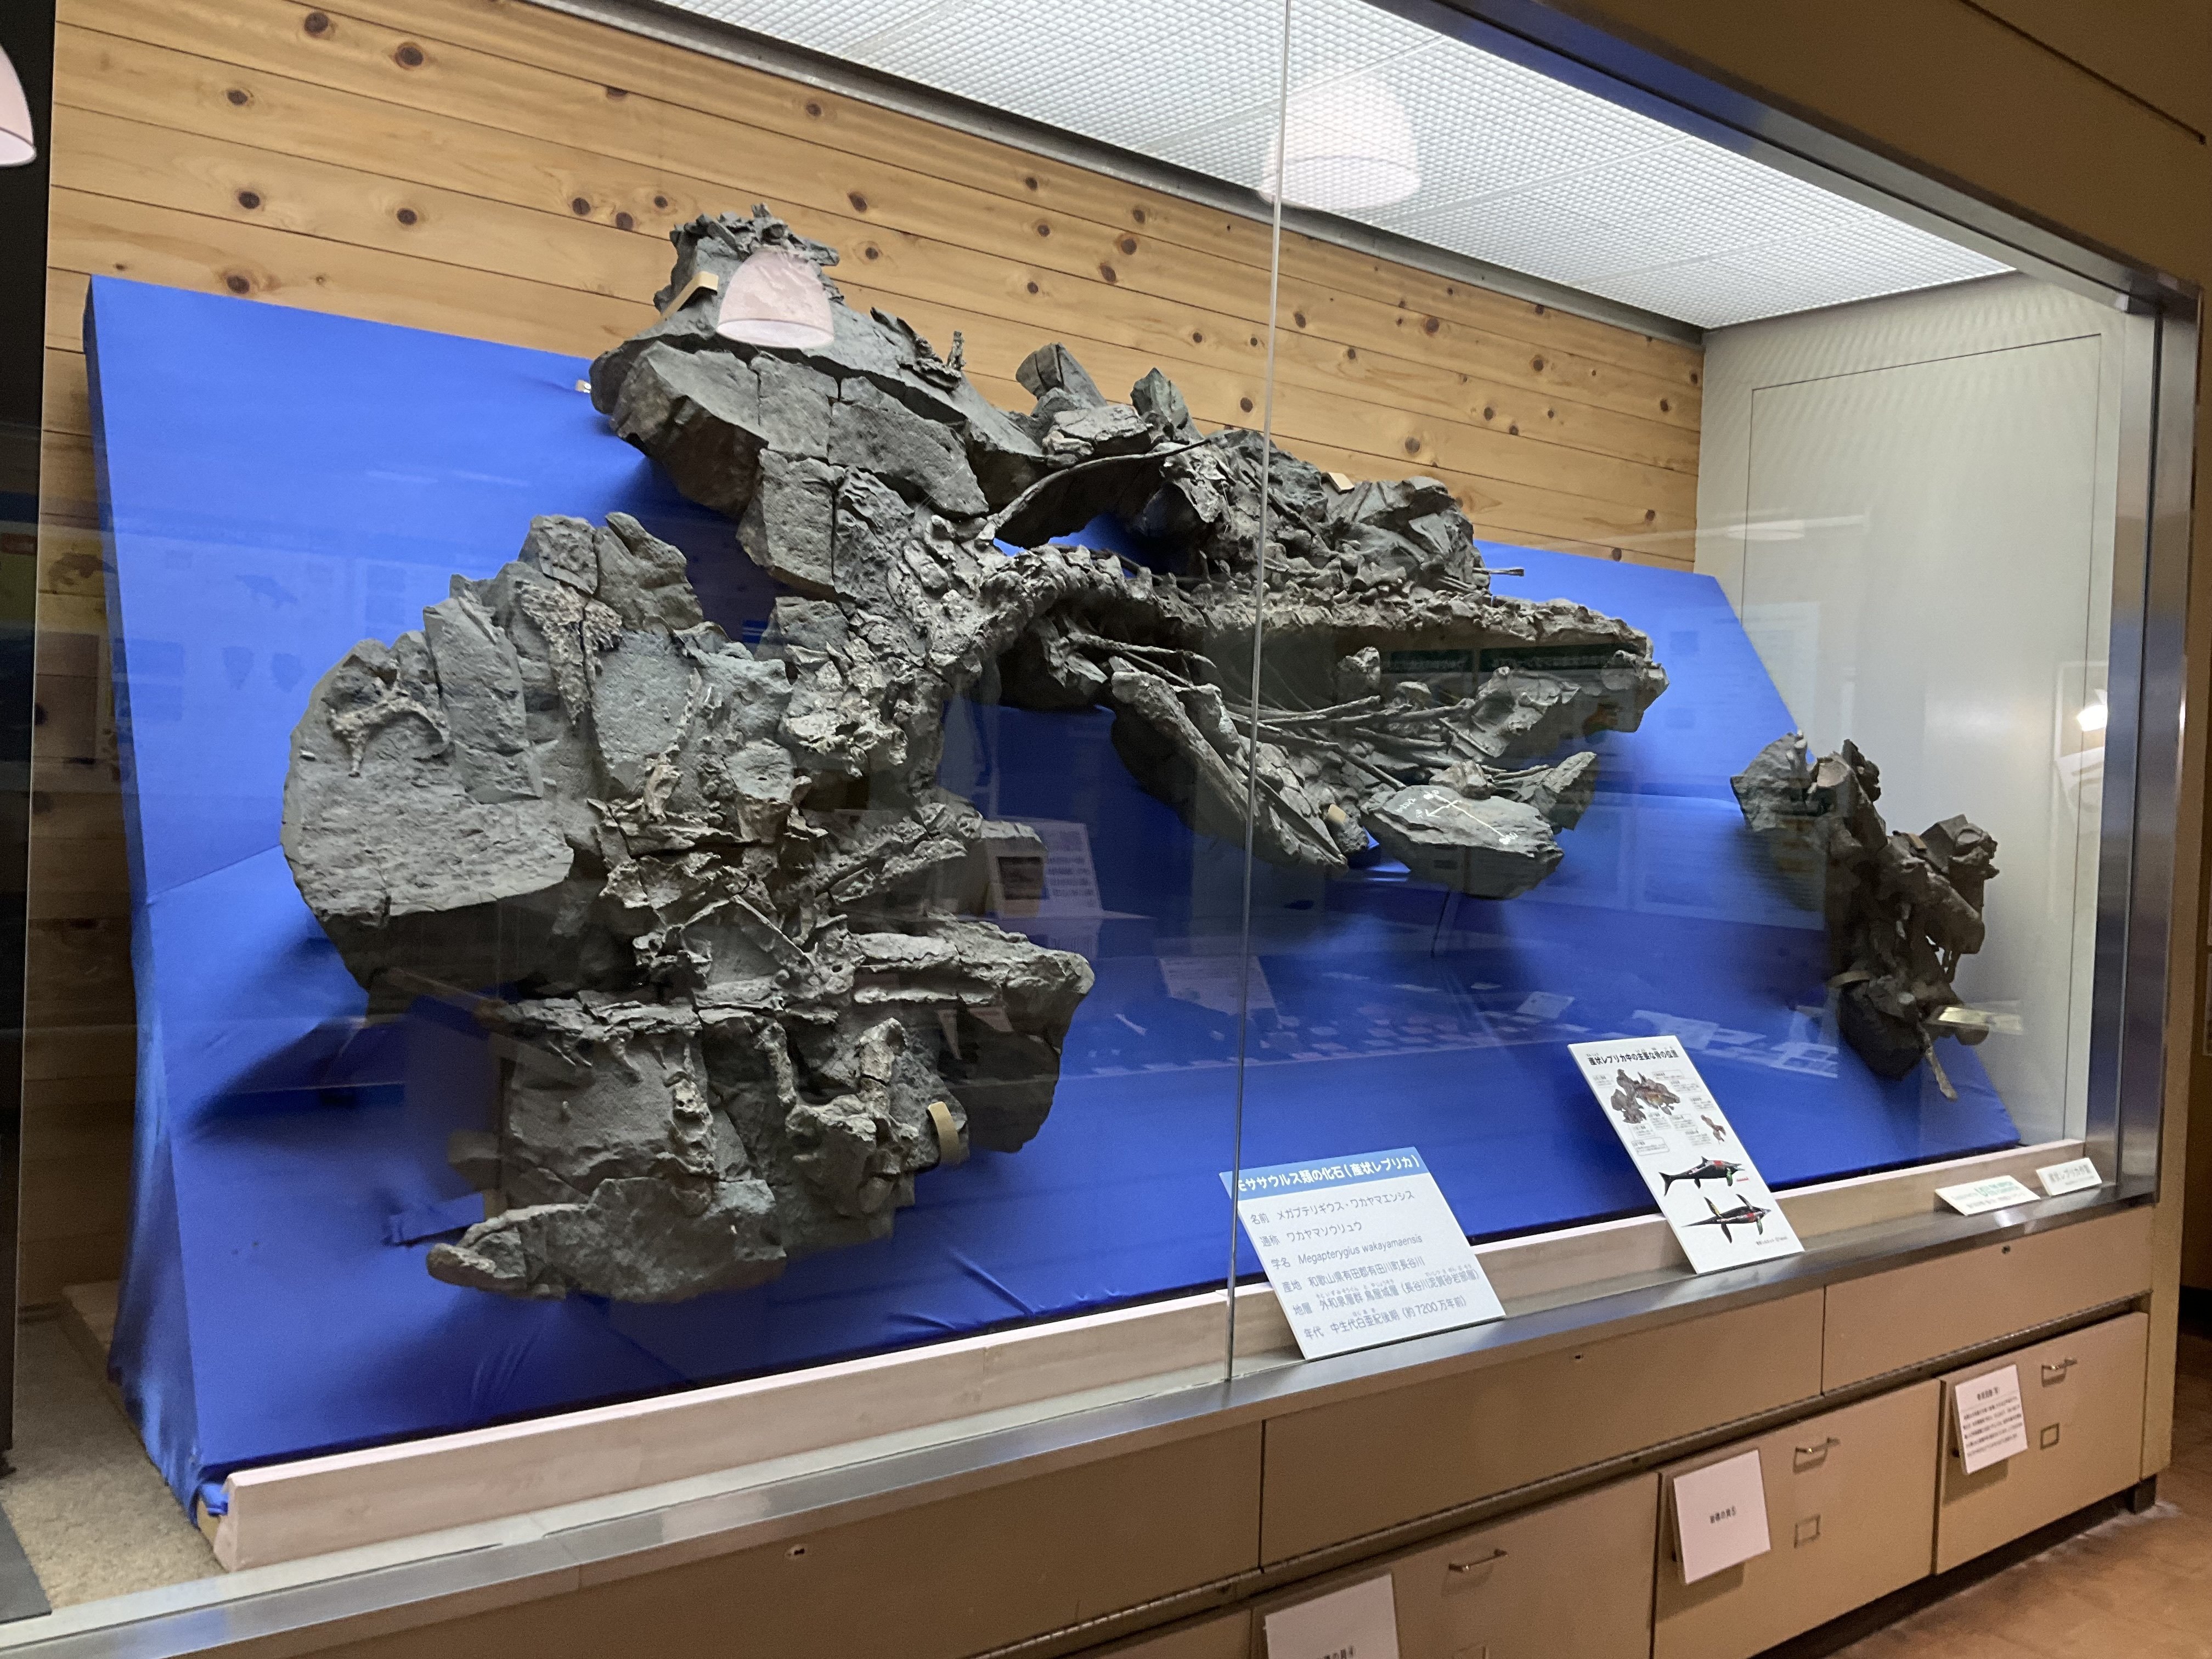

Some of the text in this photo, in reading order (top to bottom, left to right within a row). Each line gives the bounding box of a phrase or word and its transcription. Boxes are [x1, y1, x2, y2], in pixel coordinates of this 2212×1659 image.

[1250, 1212, 1270, 1224] 名前
[1259, 1221, 1362, 1247] 通称 ワカヤマソウリュウ
[1271, 1234, 1423, 1269] 学名 Megapterygius wakayamaensis
[1282, 1279, 1302, 1293] 産地
[1307, 1256, 1426, 1288] 和歌山県有田郡有田川町長谷川
[1293, 1302, 1313, 1316] 地層
[1304, 1325, 1325, 1340] 年代
